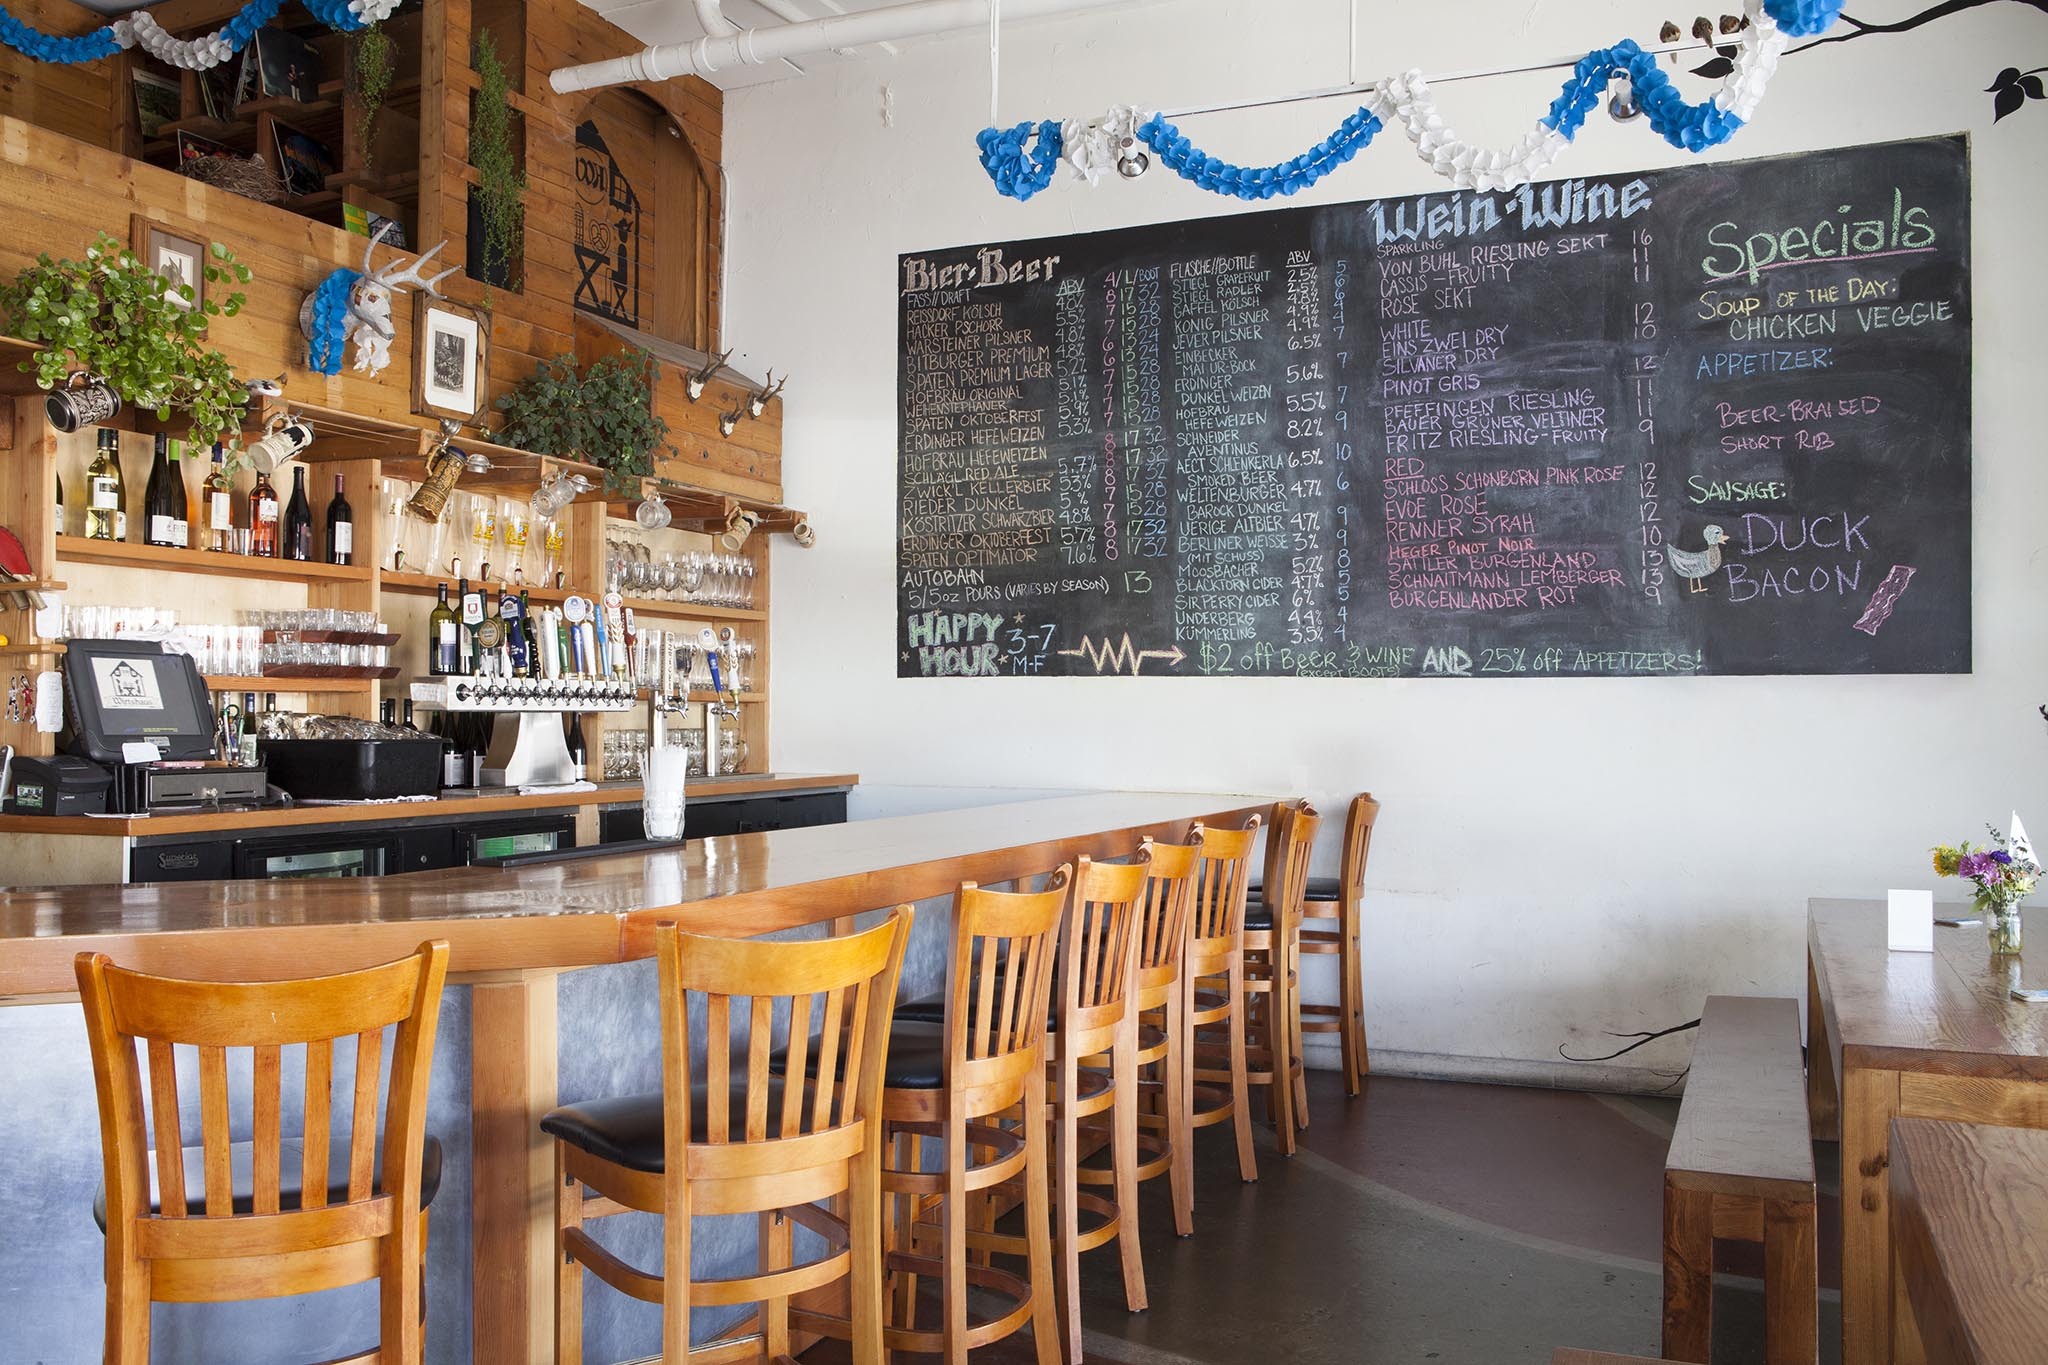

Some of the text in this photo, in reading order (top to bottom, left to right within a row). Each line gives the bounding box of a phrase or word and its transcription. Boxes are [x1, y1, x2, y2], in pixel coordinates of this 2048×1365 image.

[1701, 187, 1936, 285] Specials
[1287, 250, 1311, 265] ABV
[1377, 239, 1445, 258] SPARKLING
[1379, 233, 1608, 278] VON BUHL RIESLING SEKT
[1216, 270, 1271, 286] GRAPEFRUIT
[1380, 274, 1427, 298] CASSIS
[1217, 284, 1263, 298] RADLER
[1806, 286, 1839, 304] THE
[1381, 286, 1476, 319] ROSE SEKT
[907, 306, 960, 324] REISSDORF
[1221, 309, 1269, 328] PILSNER
[1730, 301, 1953, 341] CHICKEN VEGGIE
[907, 319, 1003, 340] HACKER PSCHORR
[1173, 324, 1263, 350] JEVER PILSNER
[1380, 320, 1431, 341] WHITE
[907, 329, 1032, 355] WARSTEINER PILSNER
[1382, 324, 1508, 358] EINS ZWEI DRY
[907, 346, 1049, 374] BITBURGER PREMIUM
[1175, 347, 1238, 365] EINBECKER
[1383, 347, 1499, 376] SILVANER DRY
[907, 363, 1054, 392] SPATEN PREMIUM LAGER
[1175, 375, 1232, 392] ERDINGER
[1384, 373, 1480, 398] PINOT GRIS
[970, 385, 1023, 401] ORIGINAL
[1181, 384, 1272, 406] DUNKEL WEIZEN
[1508, 388, 1595, 411] RIESLING
[906, 409, 1044, 434] SPATEN OKTOBERFEST
[1385, 415, 1442, 434] BAUER
[905, 426, 1045, 453] ERDINGER HEFEWEIZEN
[1177, 429, 1239, 446] SCHNEIDER
[1386, 432, 1441, 454] FRITZ
[1721, 435, 1784, 454] SHORT
[970, 447, 1047, 466] HEFEWEIZEN
[1188, 442, 1258, 457] AVENTINUS
[966, 465, 1019, 481] RED ALE
[1384, 458, 1425, 478] RED
[971, 479, 1051, 495] KELLERBIER
[1188, 471, 1278, 488] SMOKED BEER
[1383, 465, 1625, 500] SCHLOSS PINK ROSE
[904, 494, 1024, 517] RIEDER DUNKEL
[1187, 502, 1288, 521] BAROCK DUNKEL
[1441, 492, 1489, 515] ROSE
[982, 508, 1055, 529] SCHWARZBIER
[1234, 515, 1285, 534] ALTBIER
[1386, 513, 1536, 542] RENNER SYRAH
[903, 528, 1052, 551] ERDINGER OKTOBERFEST
[1742, 512, 1871, 554] DUCK
[1179, 536, 1243, 553] BERLINER
[1389, 537, 1536, 560] HEGER PINOT NOIR
[901, 548, 1037, 568] SPATEN OPTIMATOR
[903, 569, 984, 587] AUTOBAHN
[1252, 577, 1283, 589] CIDER
[1520, 568, 1626, 587] LEMBERGER
[1723, 560, 1861, 602] BACON
[965, 586, 1001, 603] POURS
[1245, 593, 1279, 607] CIDER
[1537, 585, 1578, 609] ROT
[1176, 611, 1255, 626] UNDERBERG
[908, 613, 1004, 648] HAPPY
[919, 642, 1000, 676] HOUR
[1365, 647, 1415, 665] WINE
[1423, 646, 1472, 674] AND
[1480, 648, 1526, 672] 25%
